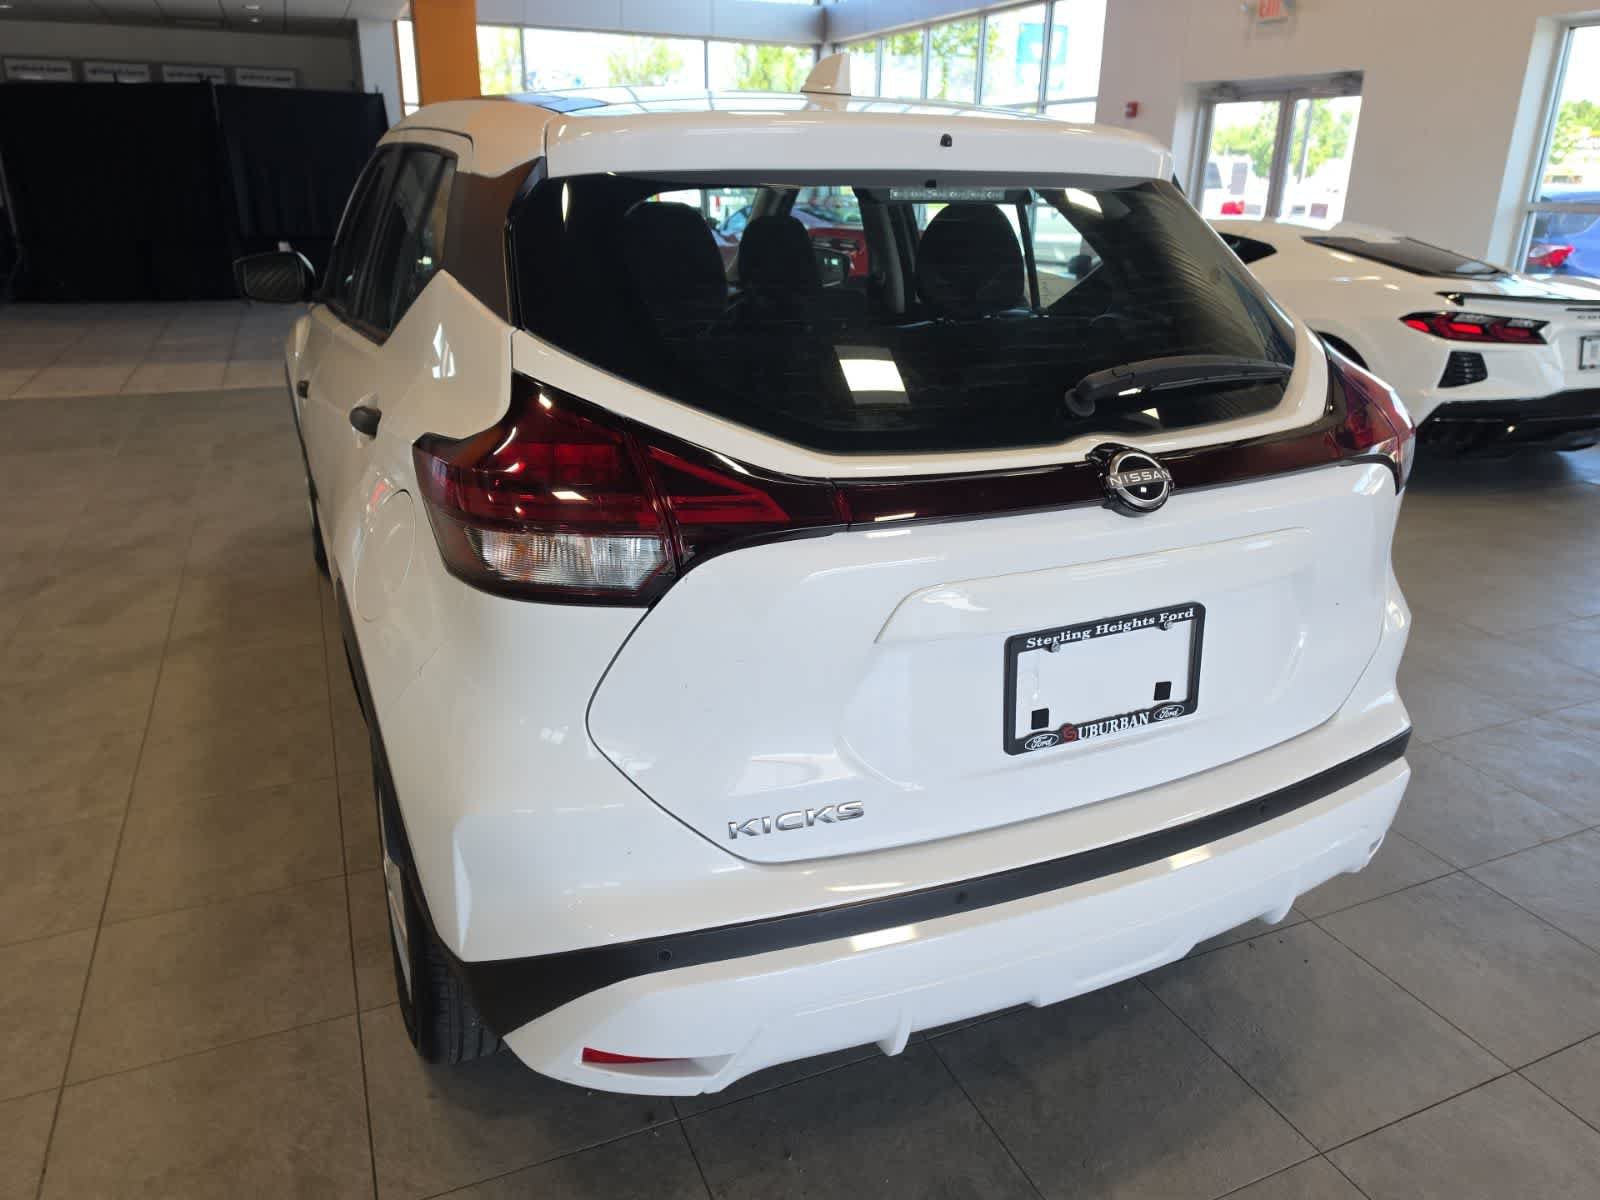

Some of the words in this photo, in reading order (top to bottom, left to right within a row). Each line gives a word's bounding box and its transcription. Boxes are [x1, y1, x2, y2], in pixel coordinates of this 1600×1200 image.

[1109, 468, 1172, 488] NISSAN
[1026, 629, 1092, 648] Sterling
[1095, 617, 1154, 635] Heights
[1158, 608, 1194, 623] Ford
[1156, 705, 1180, 719] Ford
[1062, 712, 1151, 742] SUBURBAN
[1029, 734, 1056, 749] Ford
[728, 800, 864, 839] KICKS
